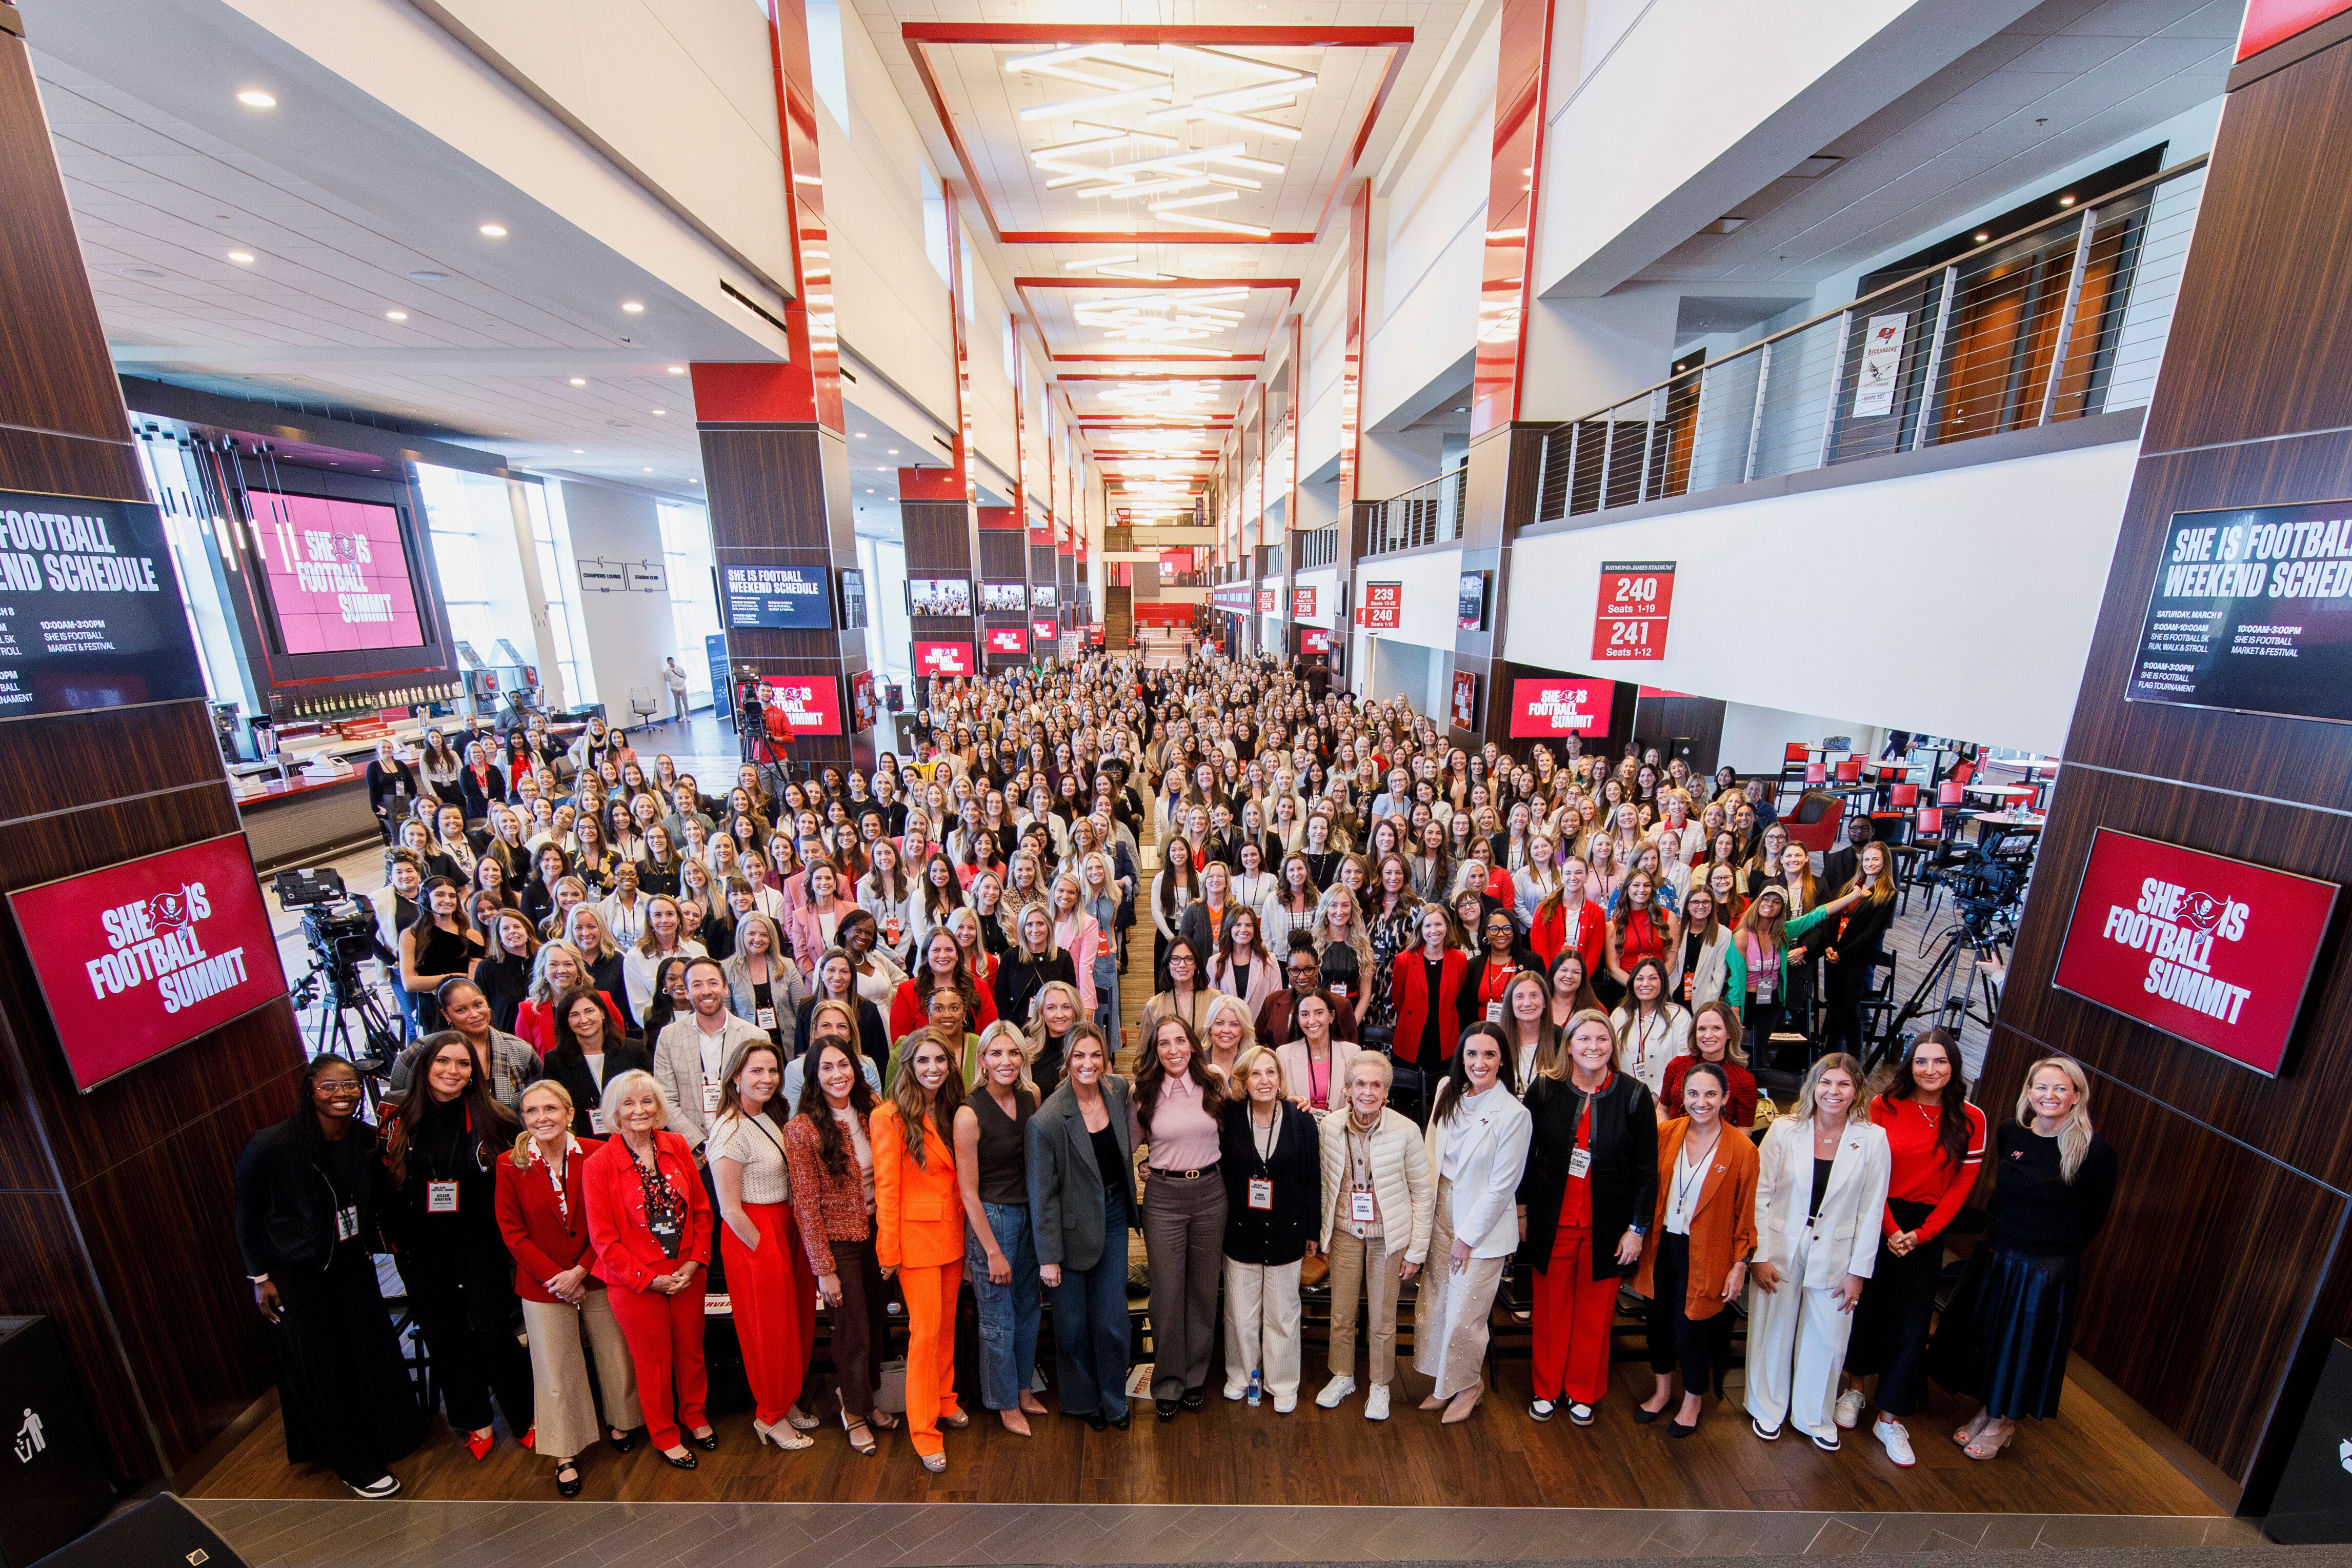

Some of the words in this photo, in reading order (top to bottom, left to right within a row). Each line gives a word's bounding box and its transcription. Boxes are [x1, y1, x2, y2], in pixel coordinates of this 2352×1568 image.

[304, 530, 336, 561] SHE
[354, 534, 371, 564] IS
[2173, 528, 2216, 562] SHE
[2216, 525, 2243, 561] IS
[2243, 519, 2352, 560] FOOTBAL
[43, 553, 159, 592] SCHEDULE
[295, 561, 368, 592] FOOTBALL
[728, 570, 746, 581] SHE
[747, 570, 757, 581] IS
[758, 570, 803, 582] FOOTBALL
[2163, 563, 2268, 597] WEEKEND
[2268, 560, 2352, 598] SCHED
[729, 581, 772, 594] WEEKEND
[773, 582, 818, 595] SCHEDULE
[1374, 588, 1394, 600] 239
[1616, 577, 1657, 601] 240
[1299, 591, 1311, 599] 238
[338, 593, 394, 623] SUMMIT
[1298, 604, 1311, 612] 239
[1607, 604, 1633, 613] Seats
[1637, 604, 1655, 613] 1-19
[2156, 610, 2190, 619] SATURDAY,
[2191, 611, 2217, 619] MARCH
[1373, 609, 1392, 621] 240
[44, 633, 59, 641] SHE
[68, 631, 104, 640] FOOTBALL
[1611, 622, 1649, 645] 241
[2150, 633, 2163, 641] SHE
[2169, 634, 2201, 642] FOOTBALL
[2201, 635, 2210, 643] 5K
[2234, 635, 2248, 644] SHE
[2248, 635, 2255, 644] IS
[2255, 636, 2293, 646] FOOTBALL
[48, 643, 77, 653] MARKET
[85, 642, 115, 651] FESTIVAL
[1606, 648, 1631, 656] Seats
[1634, 648, 1652, 656] 1-12
[2162, 643, 2180, 651] WALK
[2185, 644, 2208, 653] STROLL
[2232, 646, 2260, 655] MARKET
[2259, 647, 2265, 655] &
[2265, 648, 2298, 657] FESTIVAL
[2140, 672, 2154, 680] SHE
[2159, 673, 2189, 682] FOOTBALL
[802, 687, 812, 700] IS
[2138, 681, 2153, 689] FLAG
[2154, 681, 2196, 693] TOURNAMENT
[1541, 690, 1561, 703] SHE
[1576, 689, 1587, 703] IS
[1529, 702, 1577, 716] FOOTBALL
[786, 712, 823, 725] UMMIT
[1551, 715, 1594, 728] SUMMIT
[102, 900, 154, 949] SHE
[186, 882, 211, 922] IS
[2137, 877, 2186, 922] SHE
[2216, 900, 2249, 941] IS
[2103, 904, 2214, 973] FOOTBALL
[86, 926, 206, 1000] FOOTBALL
[158, 947, 247, 1014] SUMMIT
[2144, 957, 2251, 1025] SUMMIT
